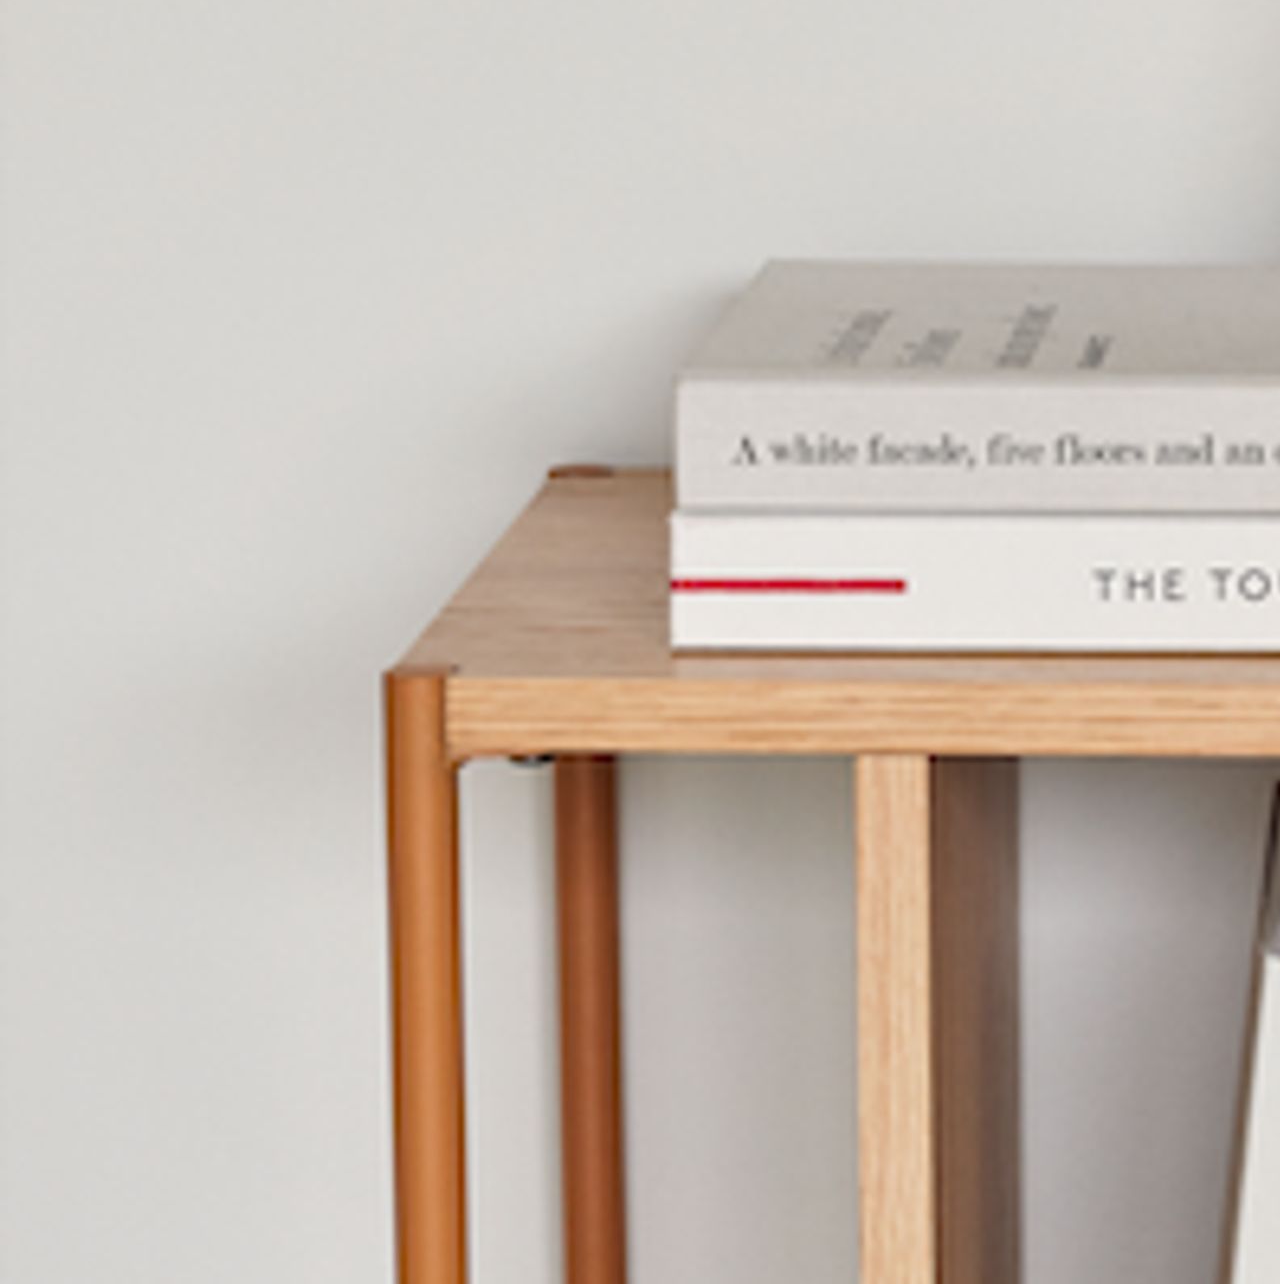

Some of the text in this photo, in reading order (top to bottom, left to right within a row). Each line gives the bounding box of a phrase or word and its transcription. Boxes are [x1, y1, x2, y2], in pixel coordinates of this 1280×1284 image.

[729, 434, 758, 466] A
[767, 433, 859, 466] white
[985, 433, 1046, 466] five
[1053, 432, 1147, 466] floors
[1154, 432, 1215, 466] and
[1224, 443, 1266, 466] an
[1095, 567, 1188, 603] THE
